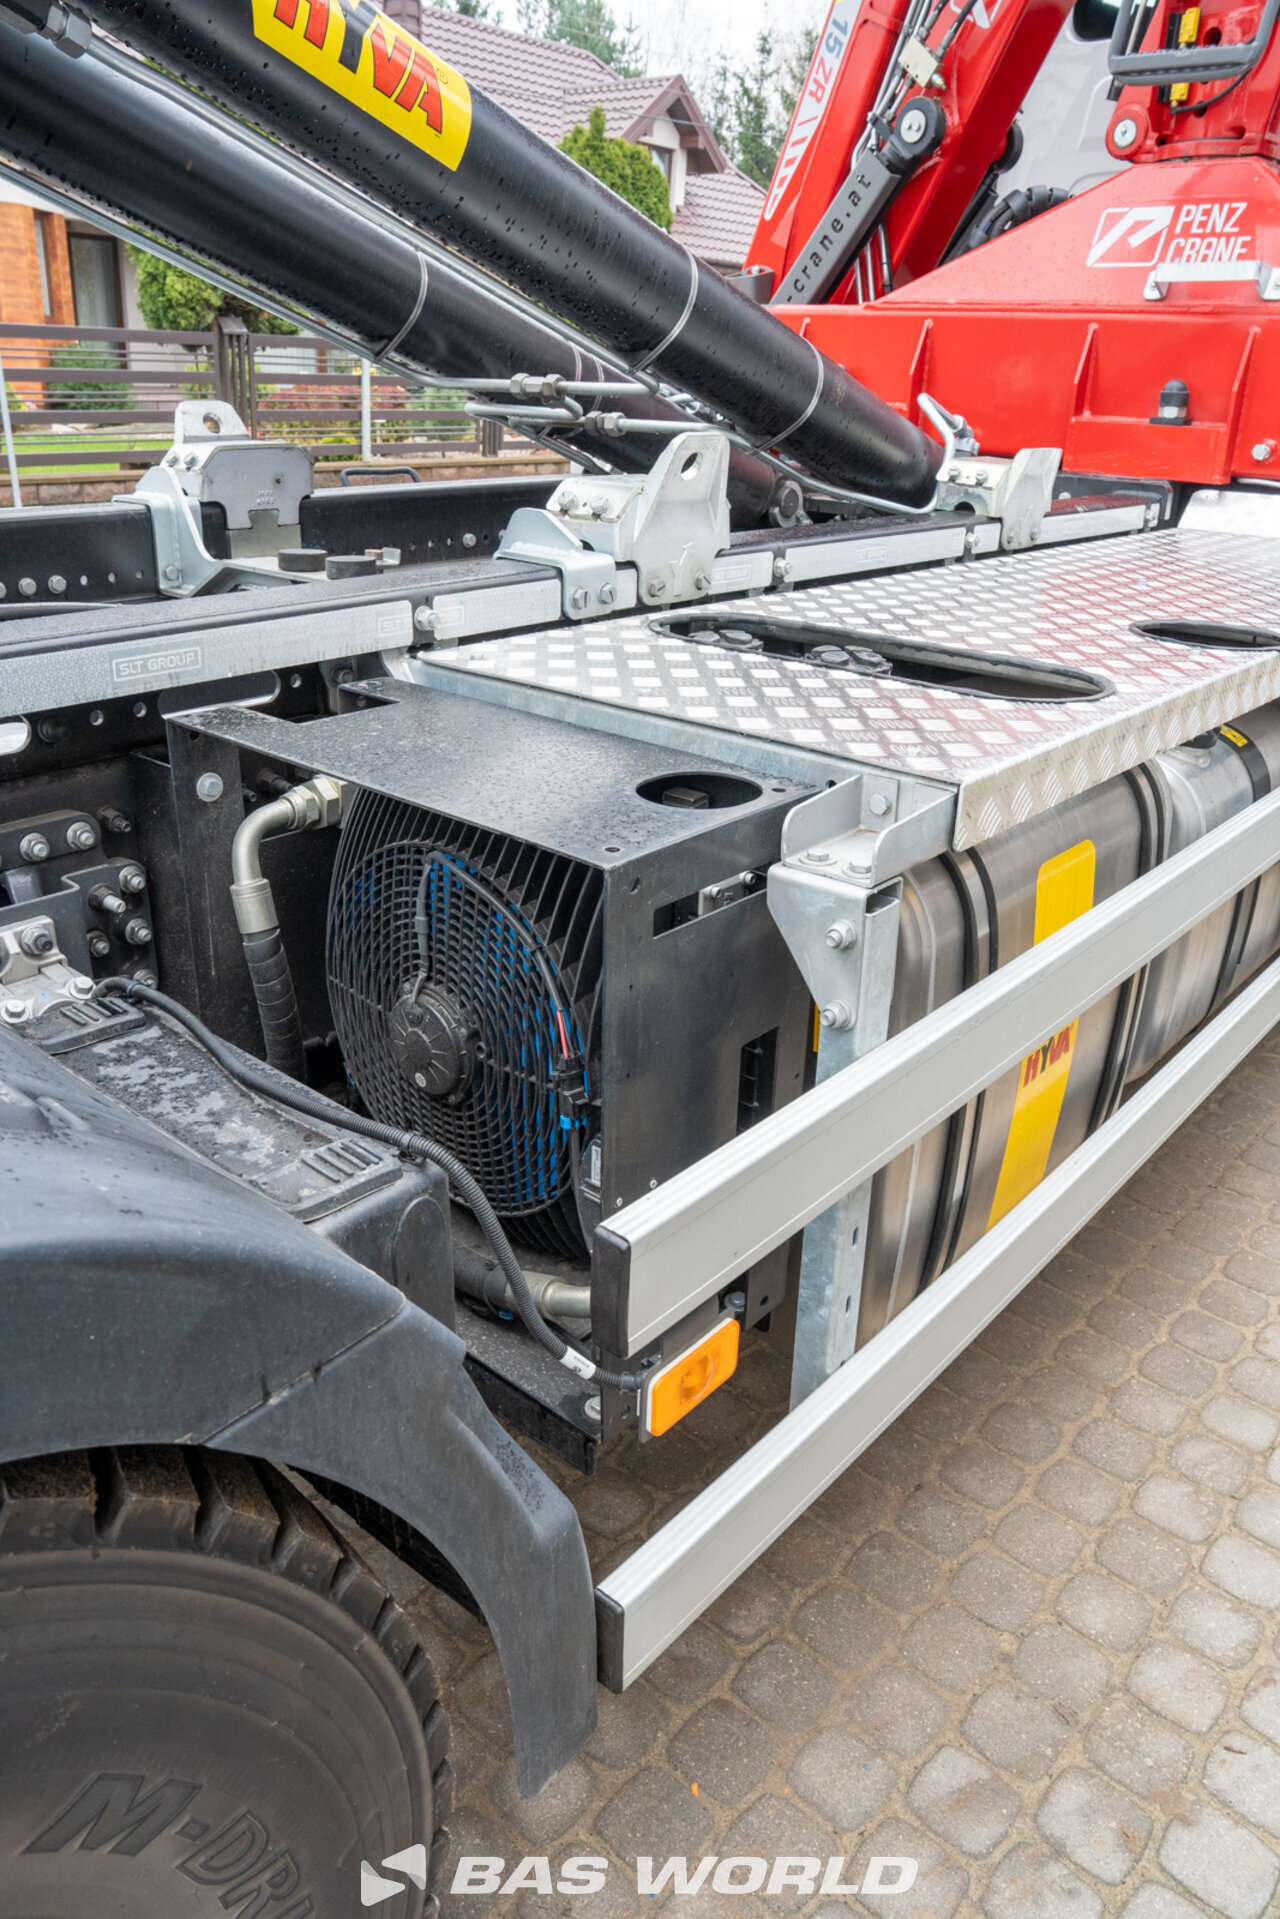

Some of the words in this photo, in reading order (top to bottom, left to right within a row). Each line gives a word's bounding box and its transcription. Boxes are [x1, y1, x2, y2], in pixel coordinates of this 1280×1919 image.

[824, 17, 848, 60] 15
[808, 56, 833, 104] ZR
[1174, 202, 1248, 234] PENZ
[1165, 236, 1252, 263] CRANE
[119, 660, 144, 676] SLT
[147, 653, 195, 671] GROUP
[1023, 1026, 1070, 1088] HYVA
